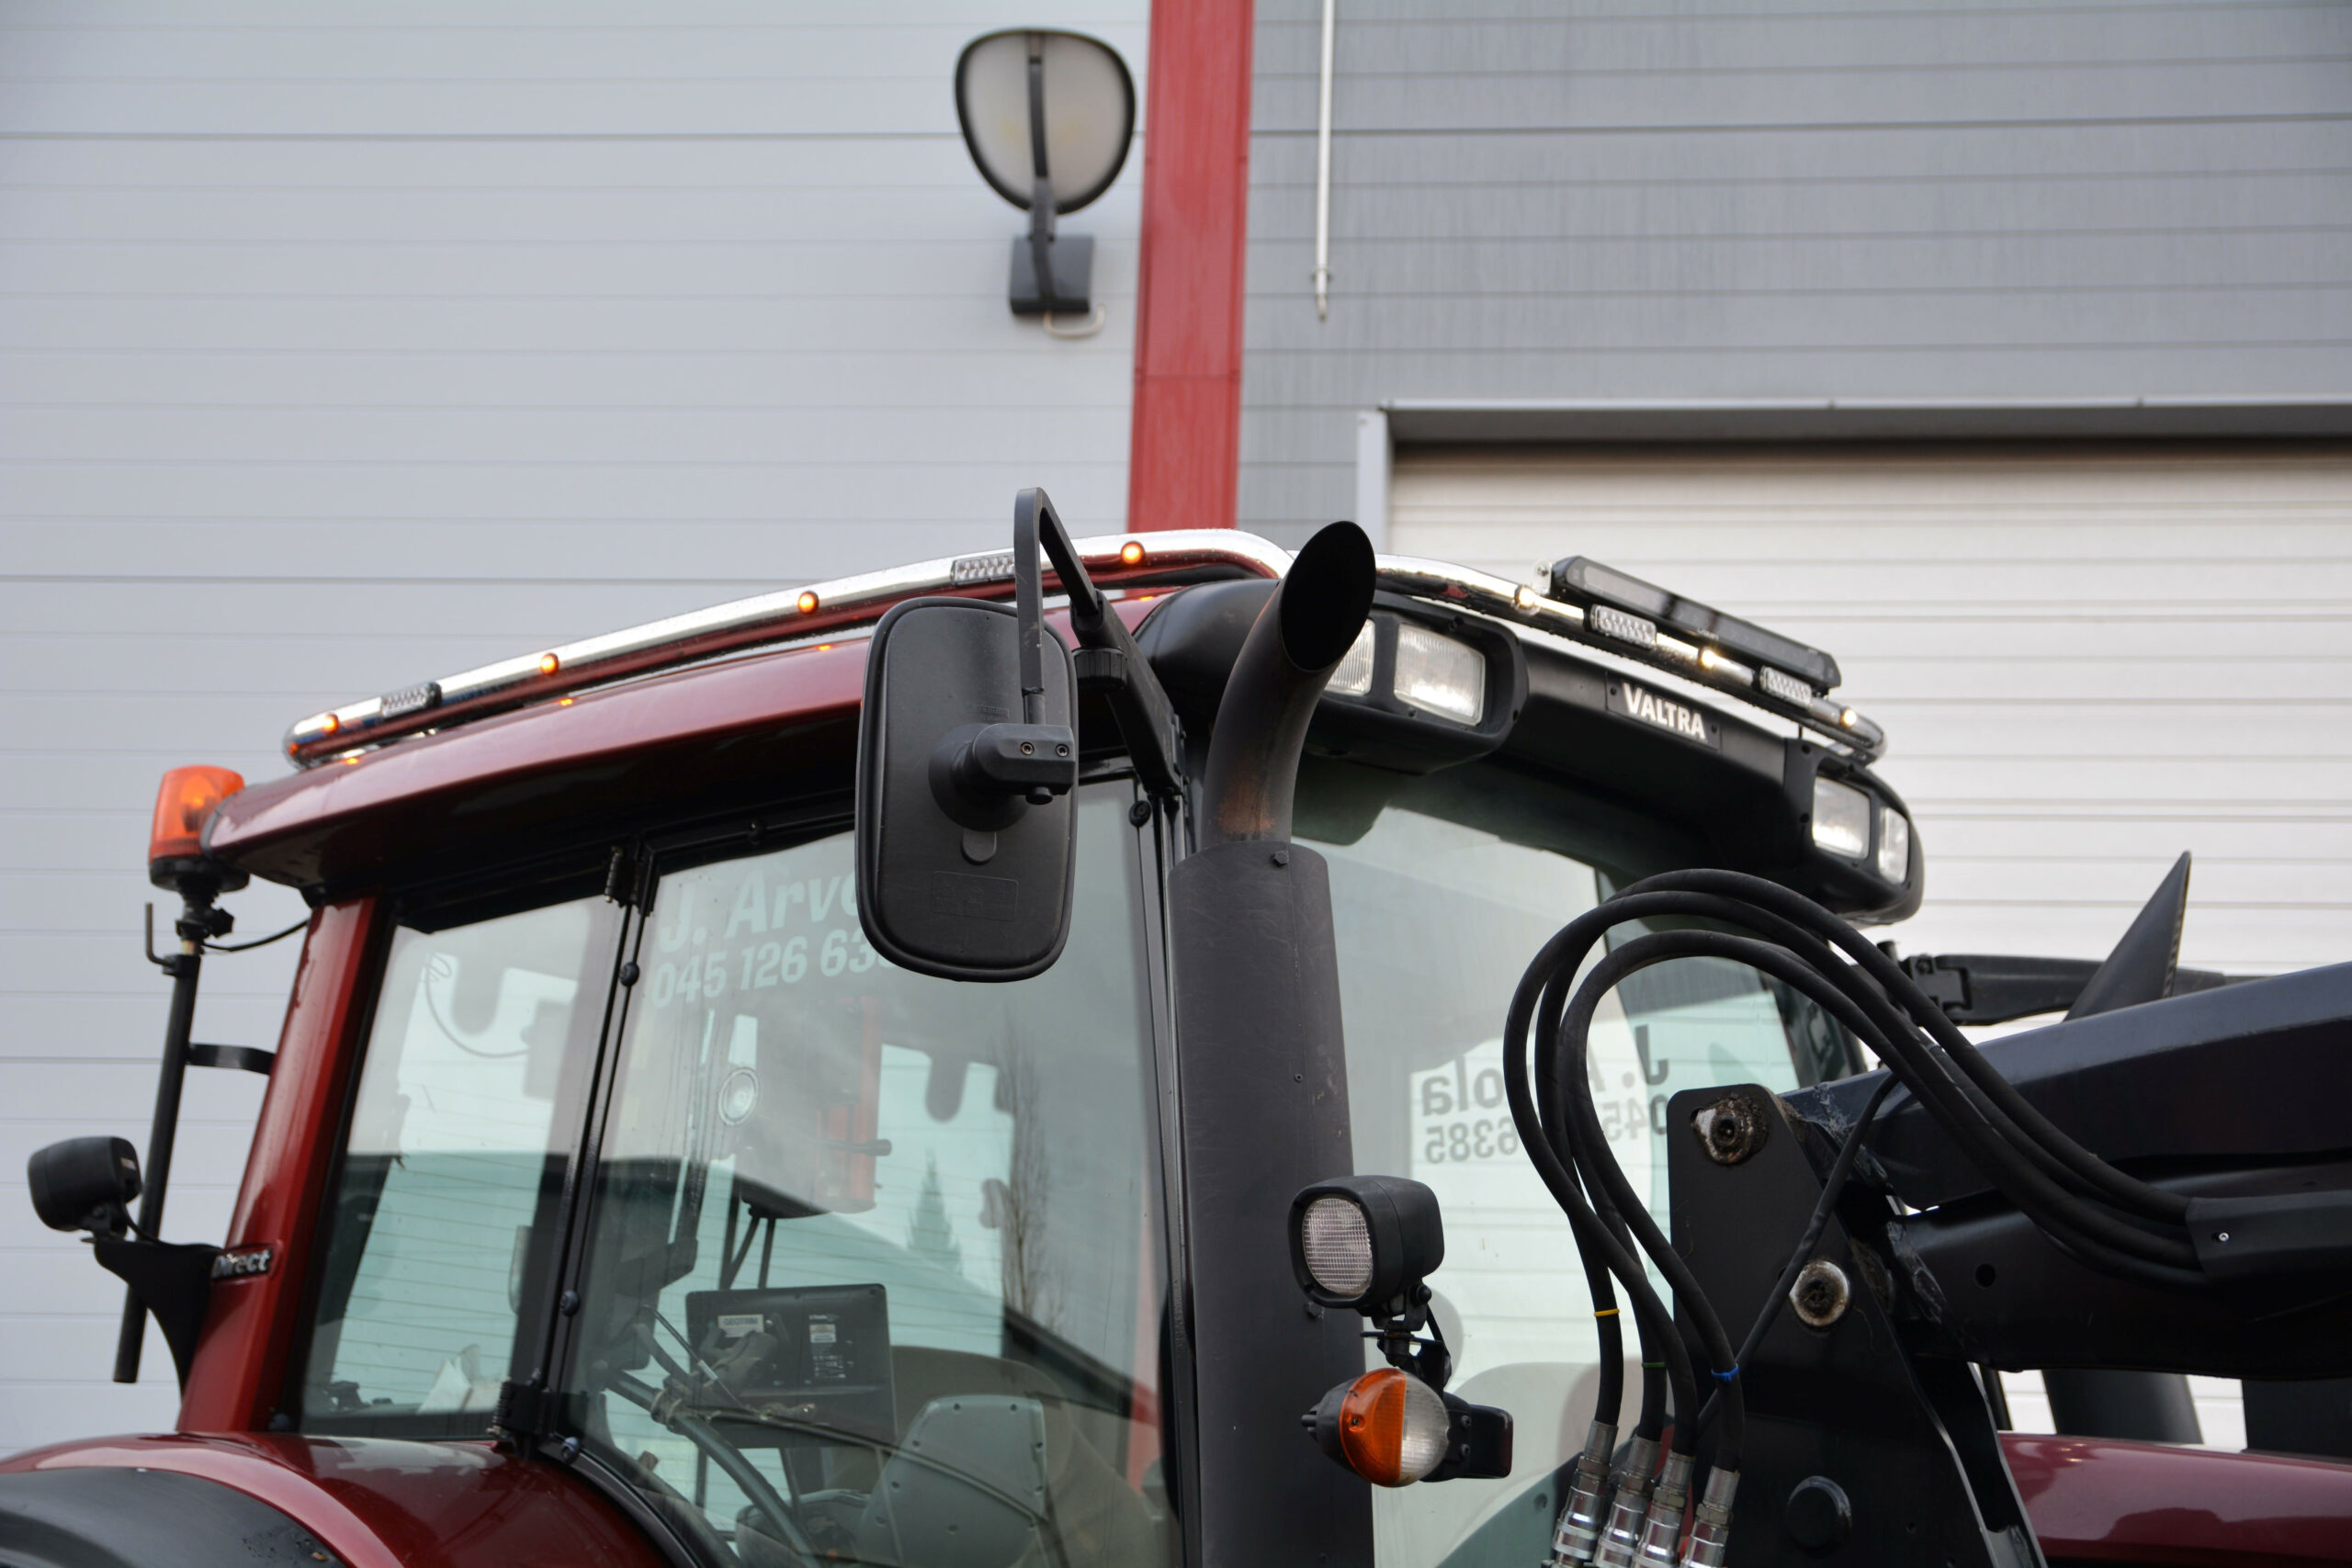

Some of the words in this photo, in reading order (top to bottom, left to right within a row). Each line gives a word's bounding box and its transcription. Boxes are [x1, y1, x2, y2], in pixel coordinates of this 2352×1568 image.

[1623, 682, 1707, 741] VALTRA
[659, 882, 707, 953] J.
[651, 951, 727, 1008] 045
[740, 936, 808, 990] 126
[820, 927, 897, 976] 63
